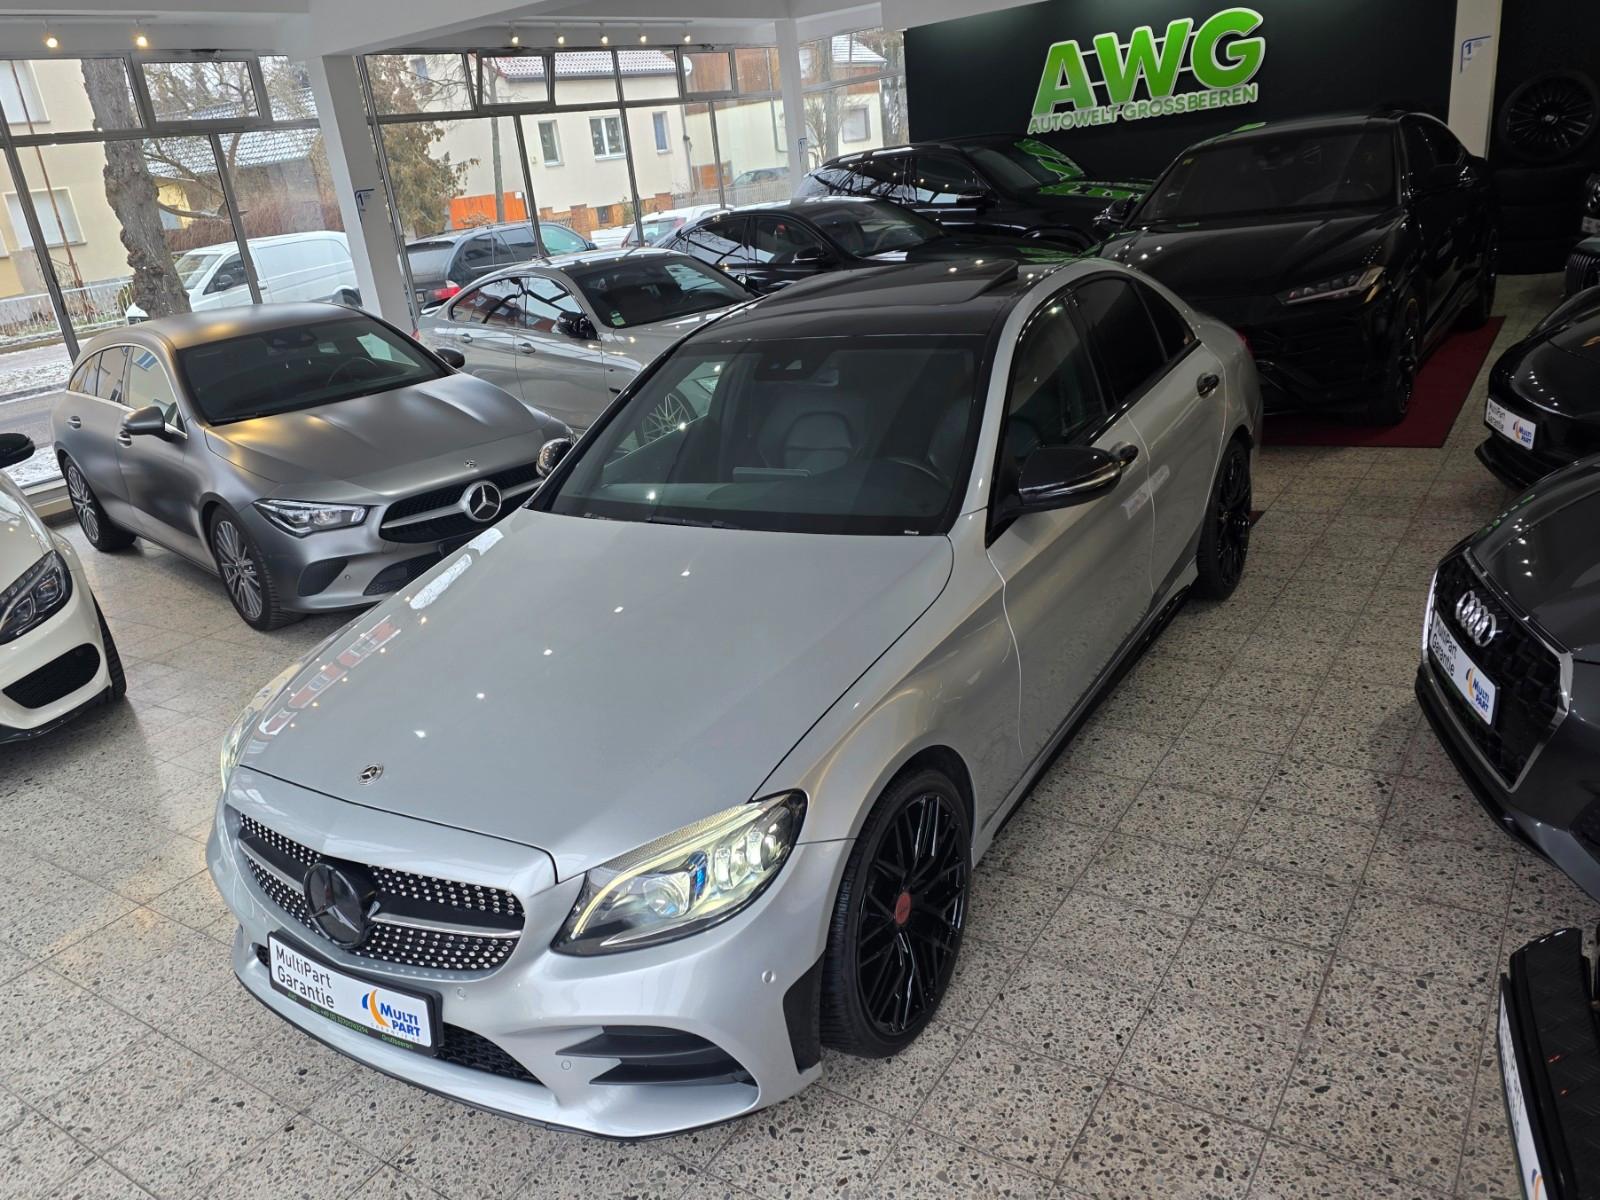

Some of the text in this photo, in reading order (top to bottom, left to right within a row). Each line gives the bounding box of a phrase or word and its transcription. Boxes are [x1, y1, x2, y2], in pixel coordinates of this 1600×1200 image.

[1031, 7, 1266, 117] AWG
[1028, 83, 1258, 135] AUTOWELT GROSSBEEREN
[275, 944, 332, 988] MultiPart
[277, 966, 335, 1009] Garantie
[380, 1002, 419, 1026] MULTI
[391, 1019, 421, 1037] PART
